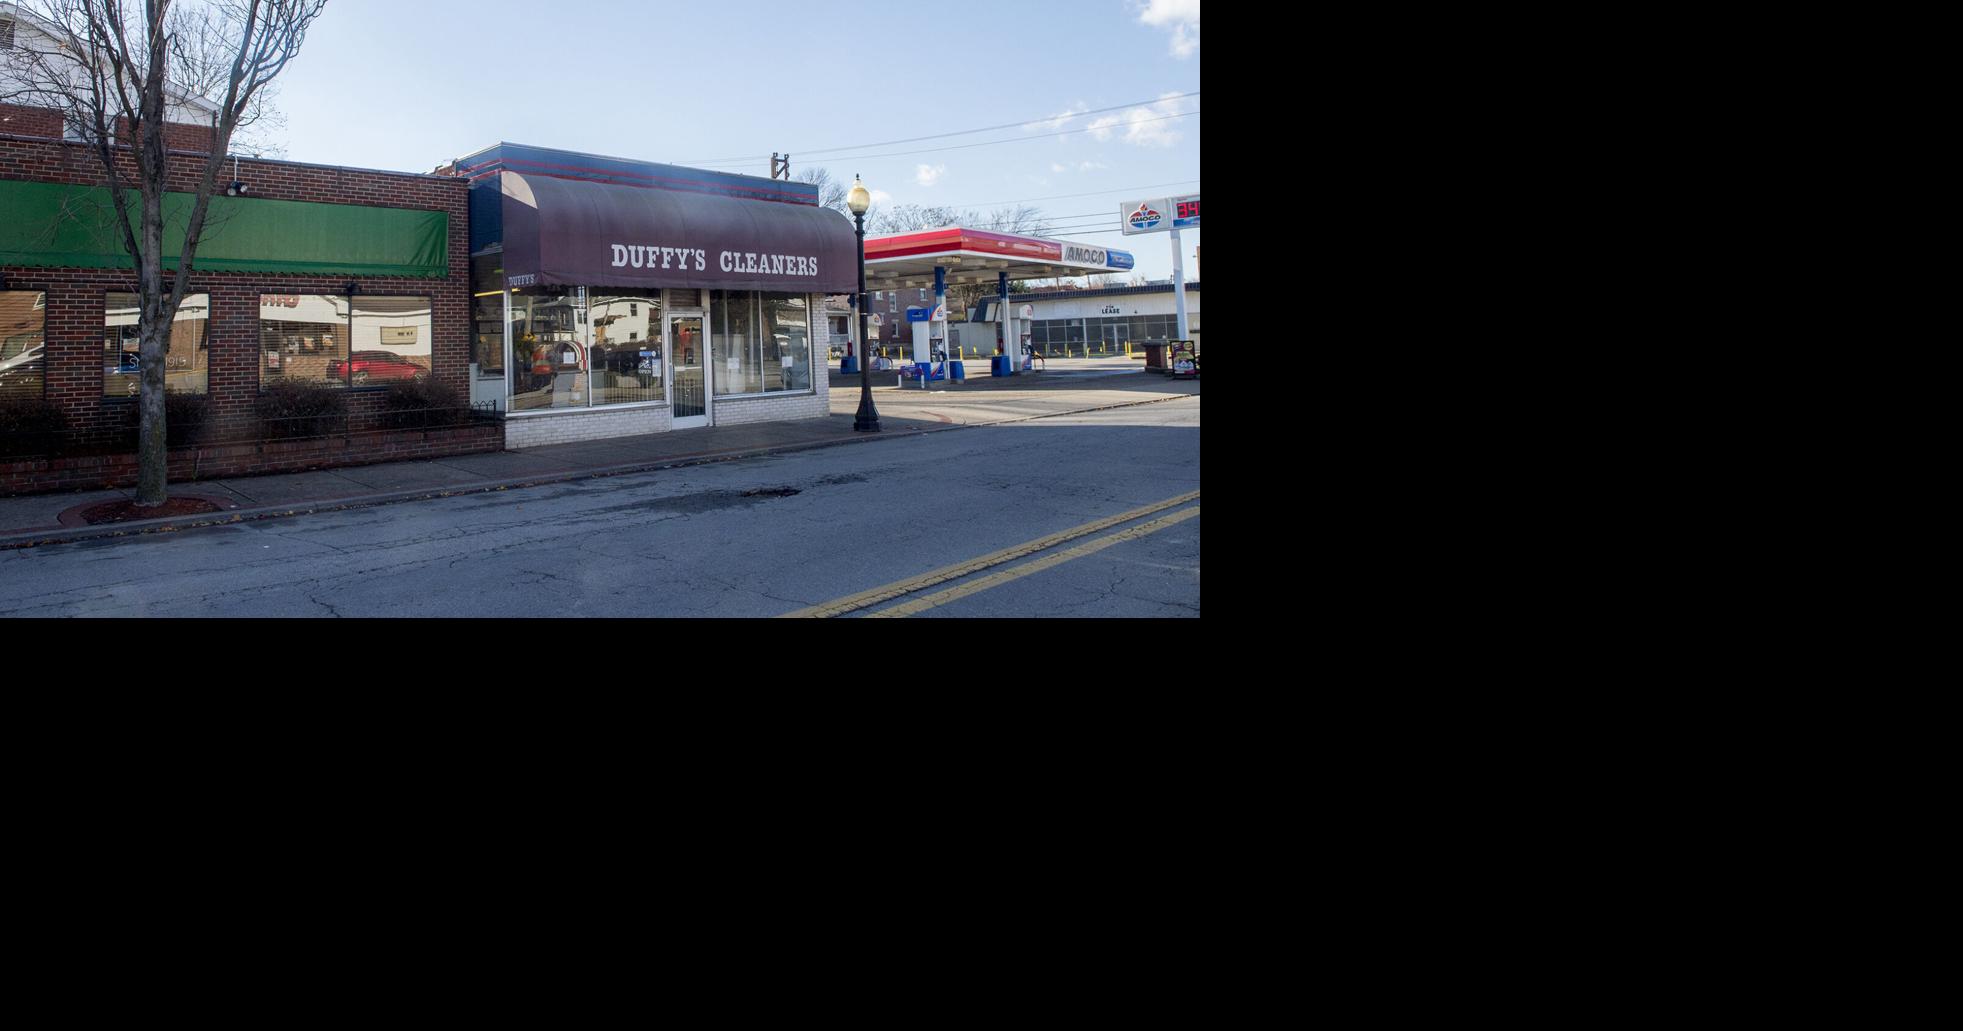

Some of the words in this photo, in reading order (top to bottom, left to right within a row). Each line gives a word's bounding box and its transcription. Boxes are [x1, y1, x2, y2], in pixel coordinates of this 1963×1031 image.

[611, 244, 706, 271] DUFFY'S
[719, 250, 818, 276] CLEANERS
[1065, 246, 1105, 265] AMOCO
